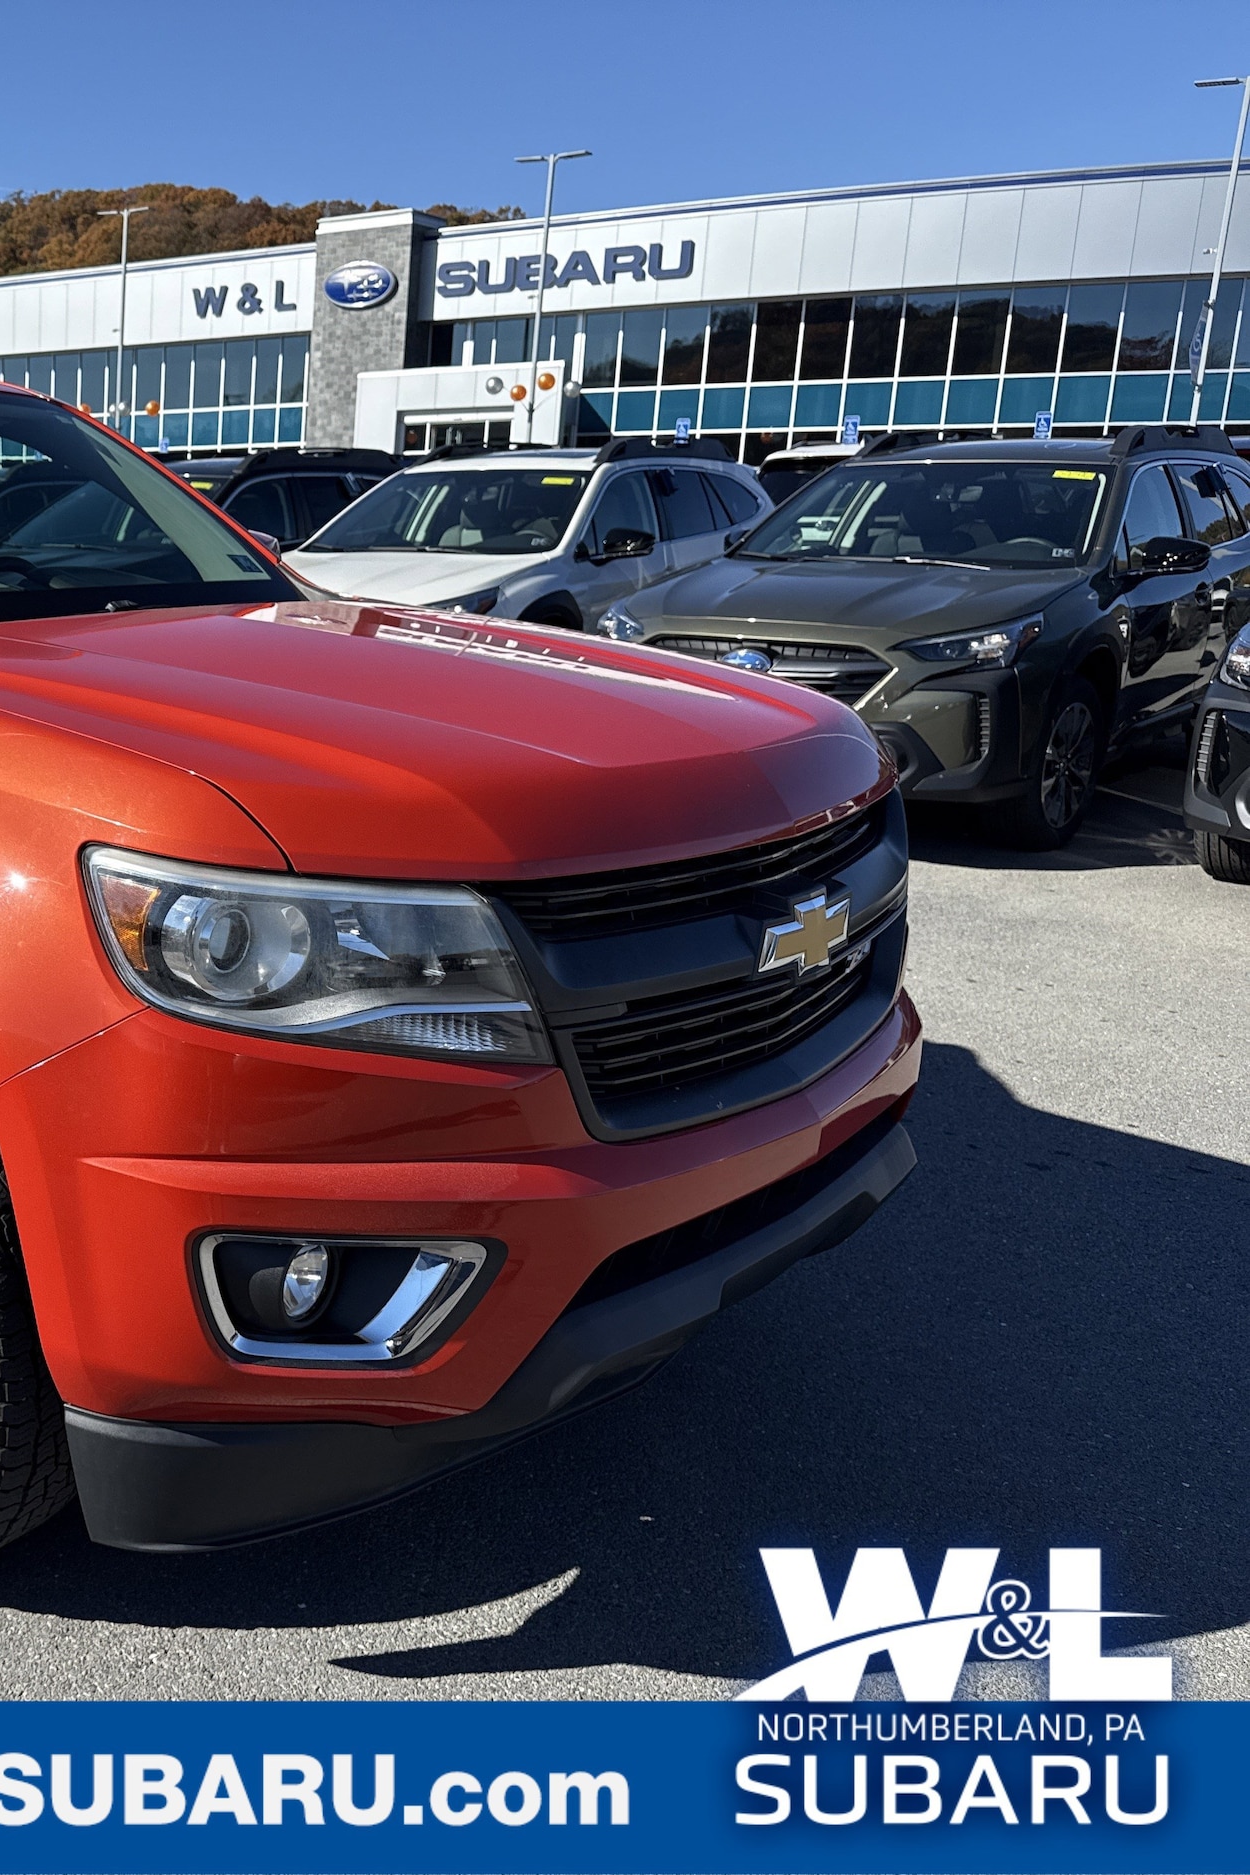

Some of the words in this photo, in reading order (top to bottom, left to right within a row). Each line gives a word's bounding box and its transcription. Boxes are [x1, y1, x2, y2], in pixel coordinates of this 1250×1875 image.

[437, 240, 695, 298] SUBARU
[192, 285, 228, 319] W
[275, 280, 297, 312] L
